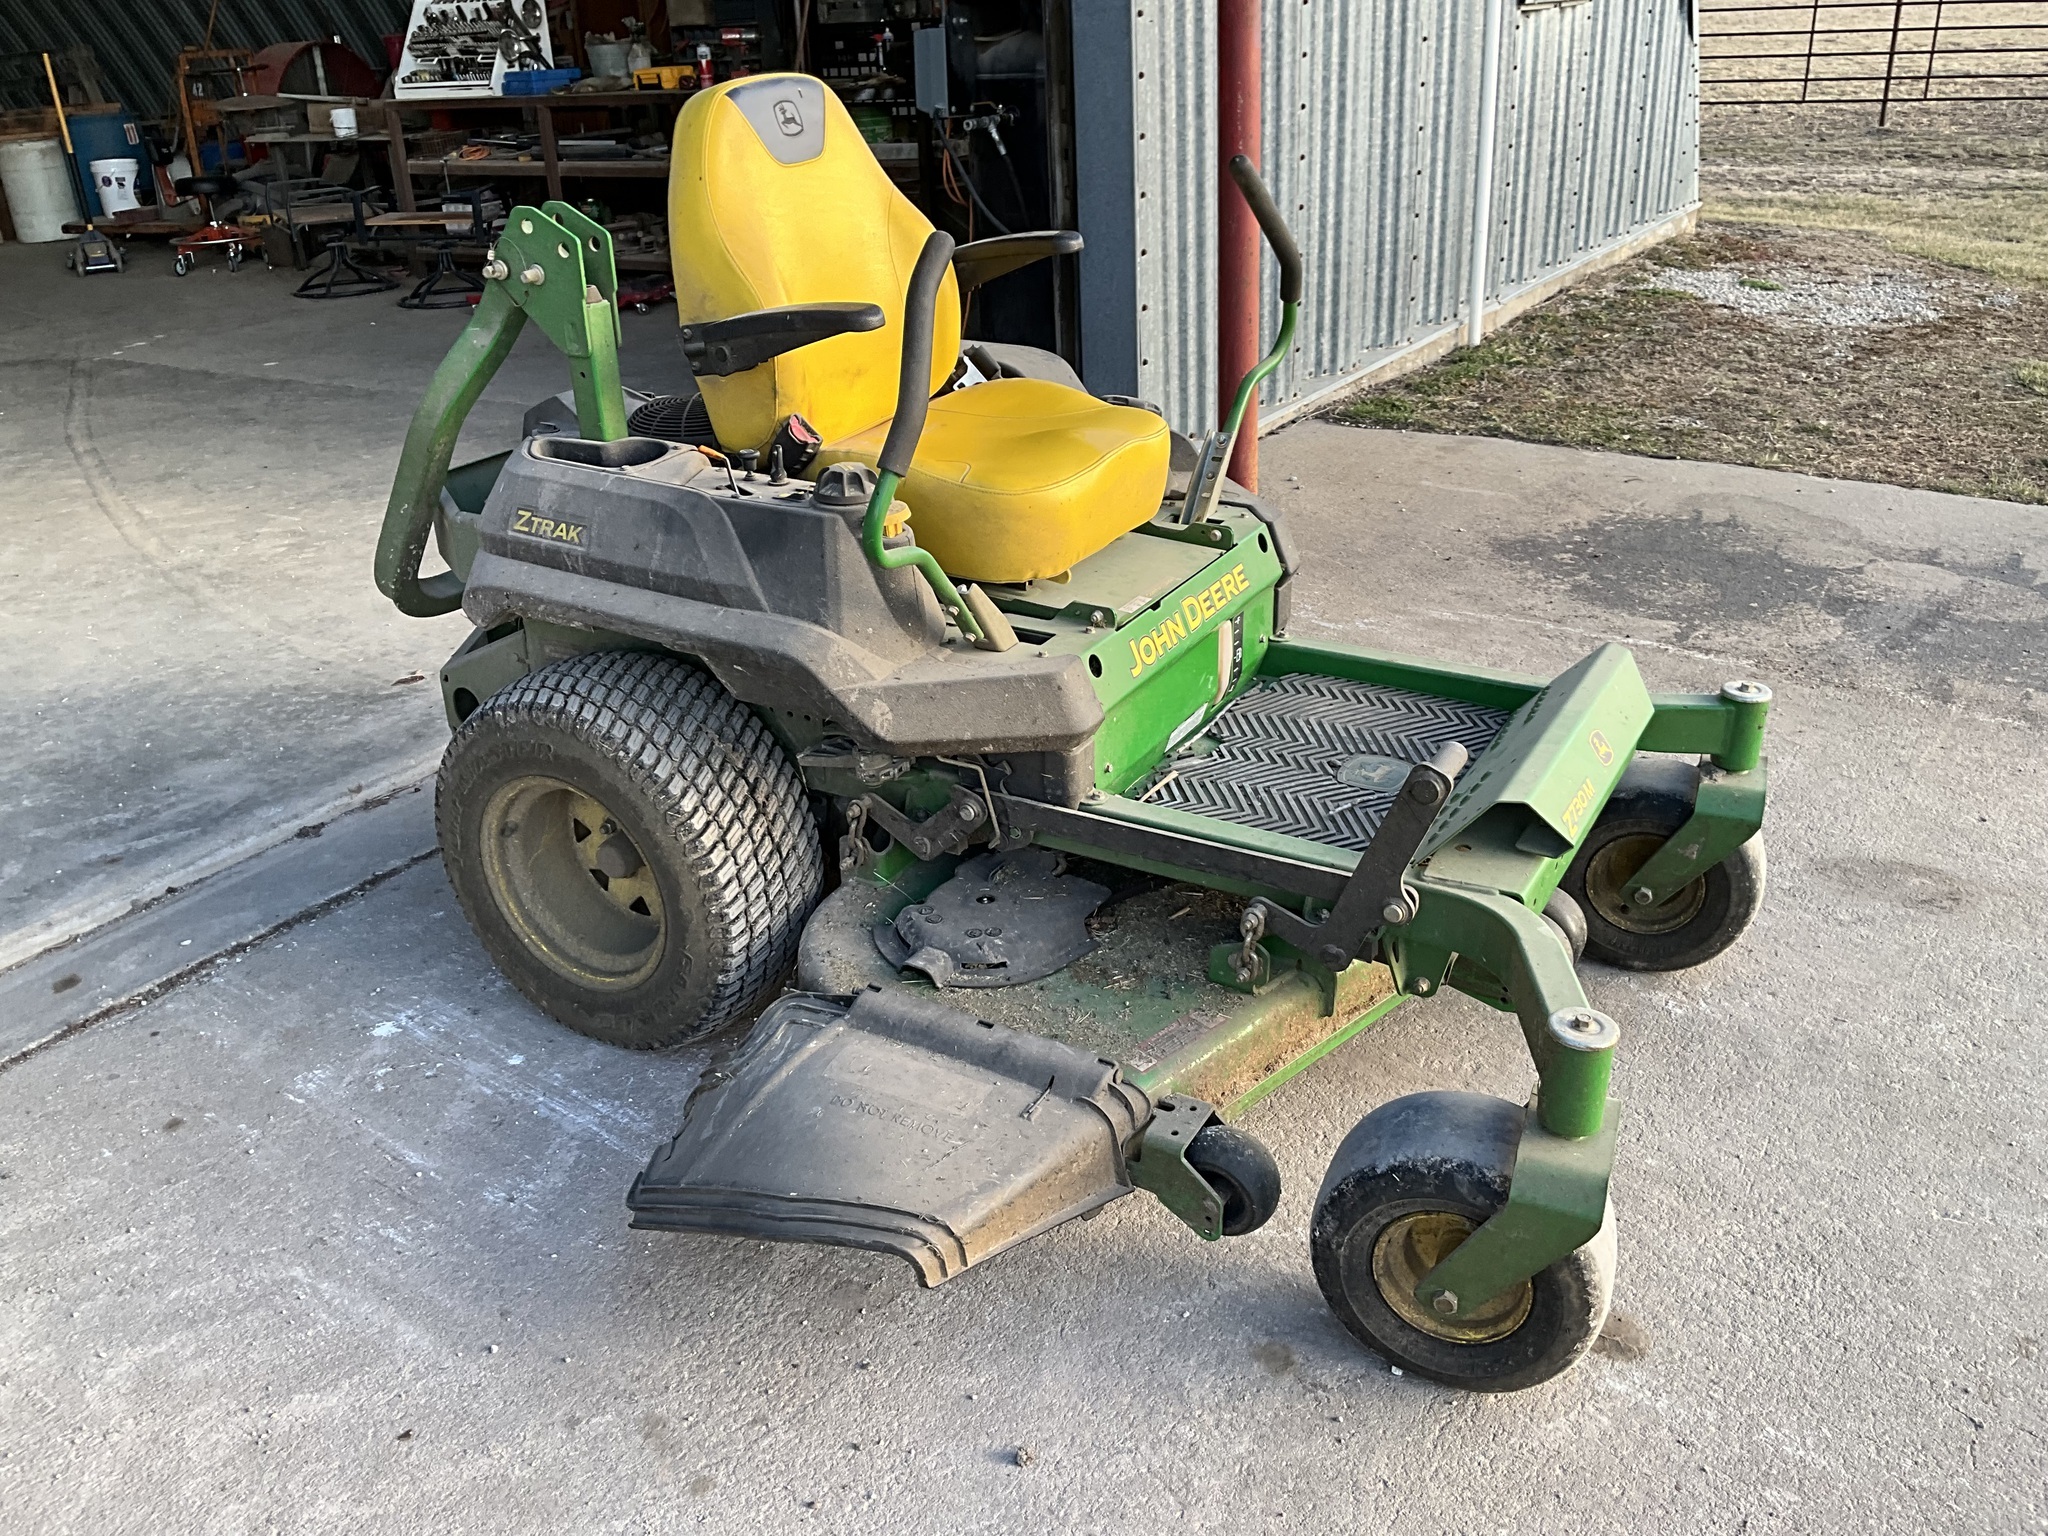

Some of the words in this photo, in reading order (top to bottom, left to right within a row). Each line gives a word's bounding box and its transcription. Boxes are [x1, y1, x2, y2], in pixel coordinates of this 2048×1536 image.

[513, 509, 583, 545] ZTRAK
[1129, 611, 1186, 678] JOHN
[1180, 563, 1249, 632] DEERE
[1561, 777, 1596, 840] Z730M
[830, 1095, 853, 1107] DO
[857, 1101, 888, 1120] NOT
[891, 1113, 954, 1143] REMOVE
